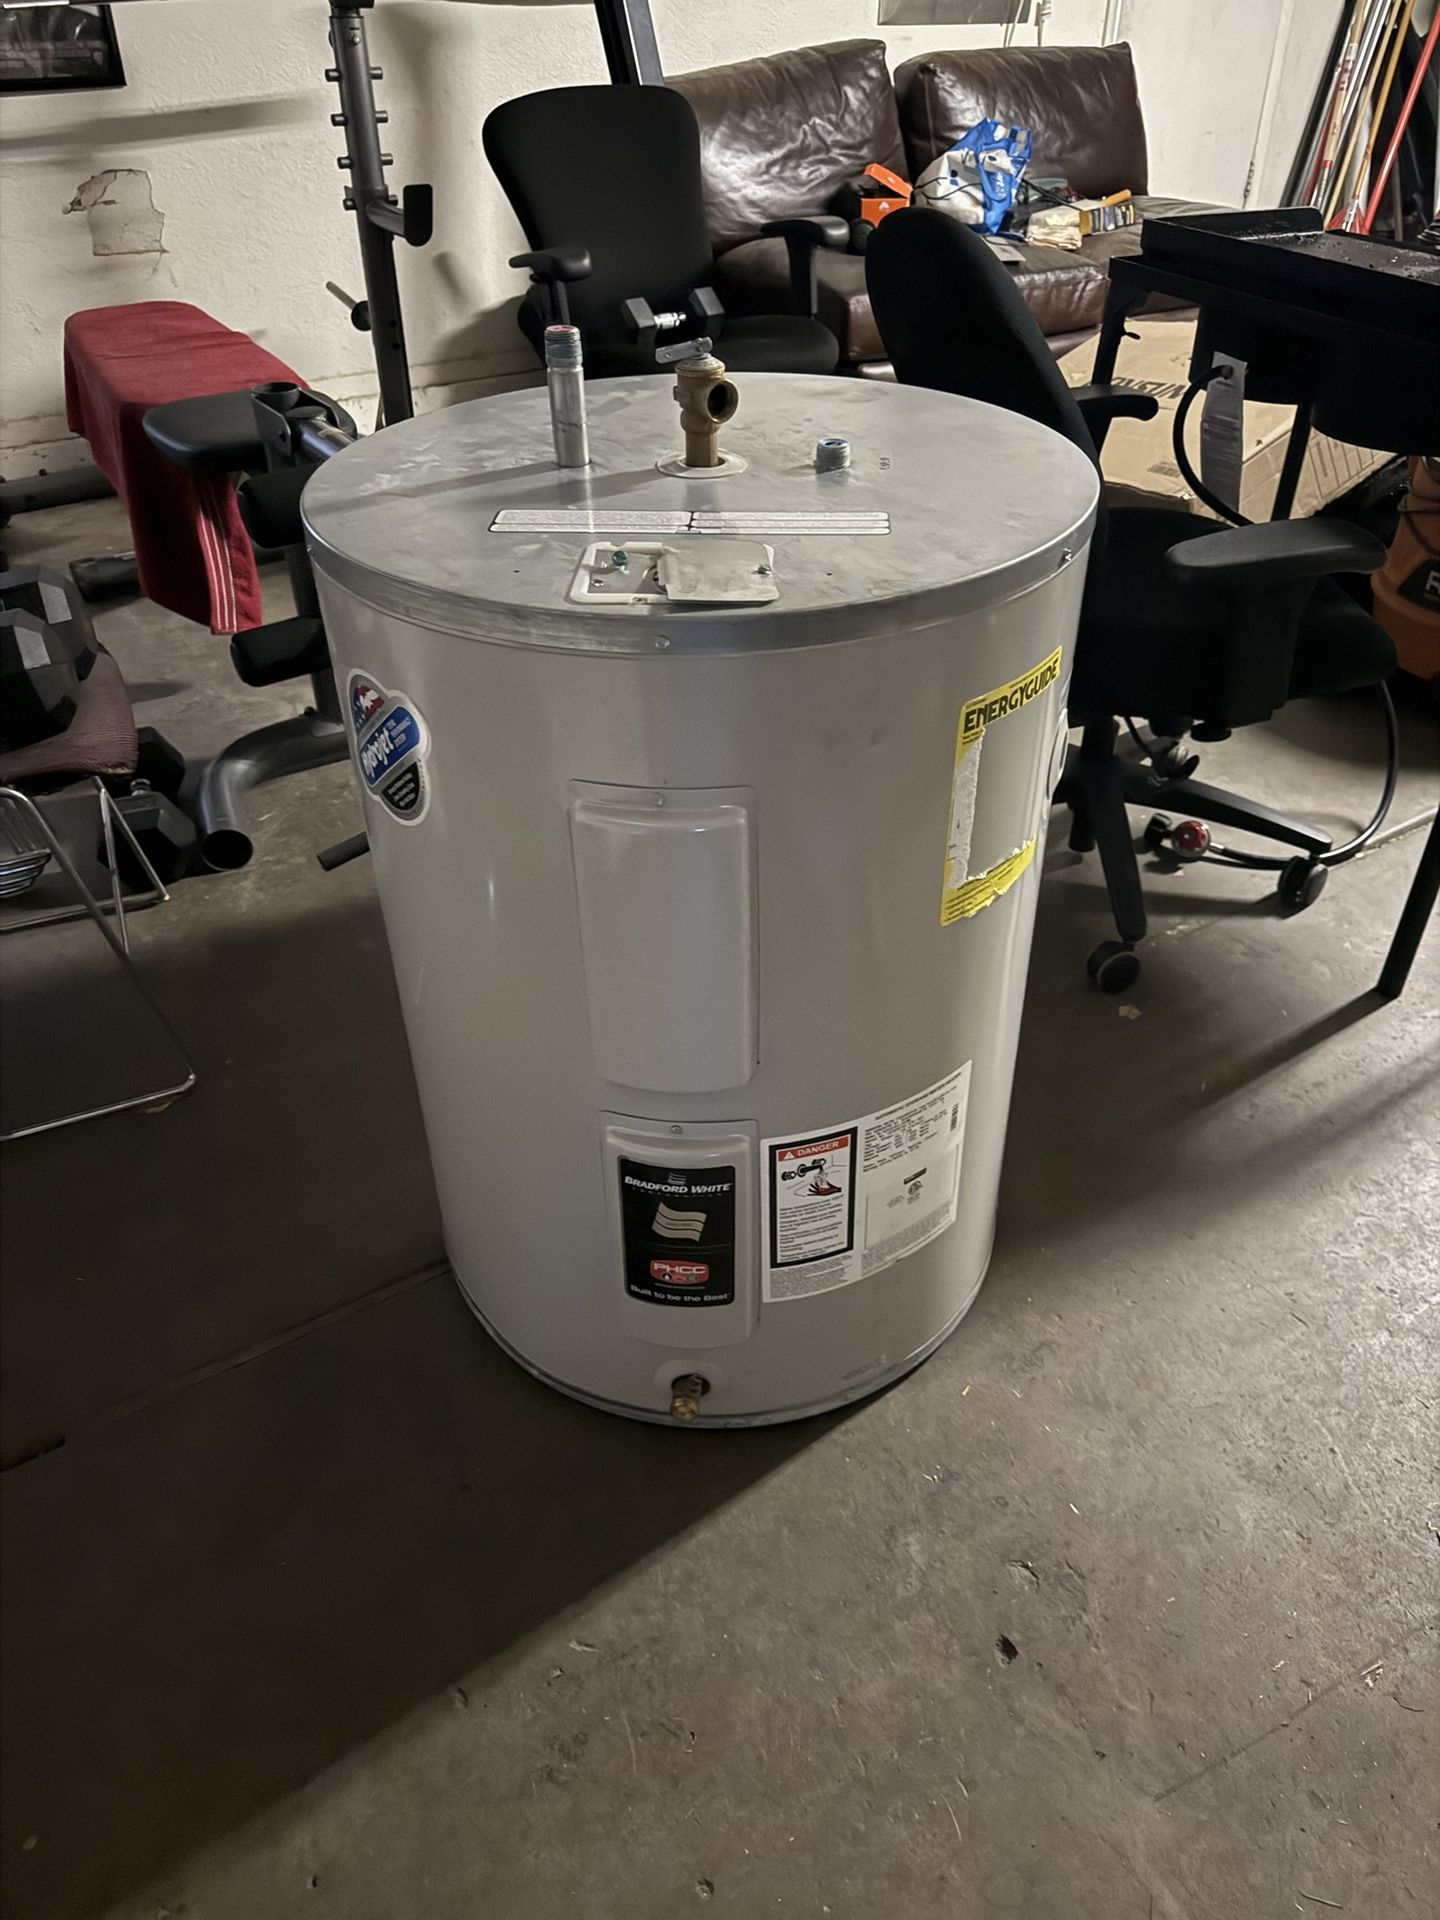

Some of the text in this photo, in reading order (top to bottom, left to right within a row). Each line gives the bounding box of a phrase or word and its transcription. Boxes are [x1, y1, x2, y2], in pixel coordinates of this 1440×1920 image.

[963, 657, 1059, 733] ENERGYGUIDE
[797, 1141, 839, 1156] DANGER
[624, 1175, 688, 1193] BRADFORD
[690, 1183, 731, 1193] WHITE
[654, 1263, 706, 1274] PHCC
[630, 1284, 652, 1296] Built
